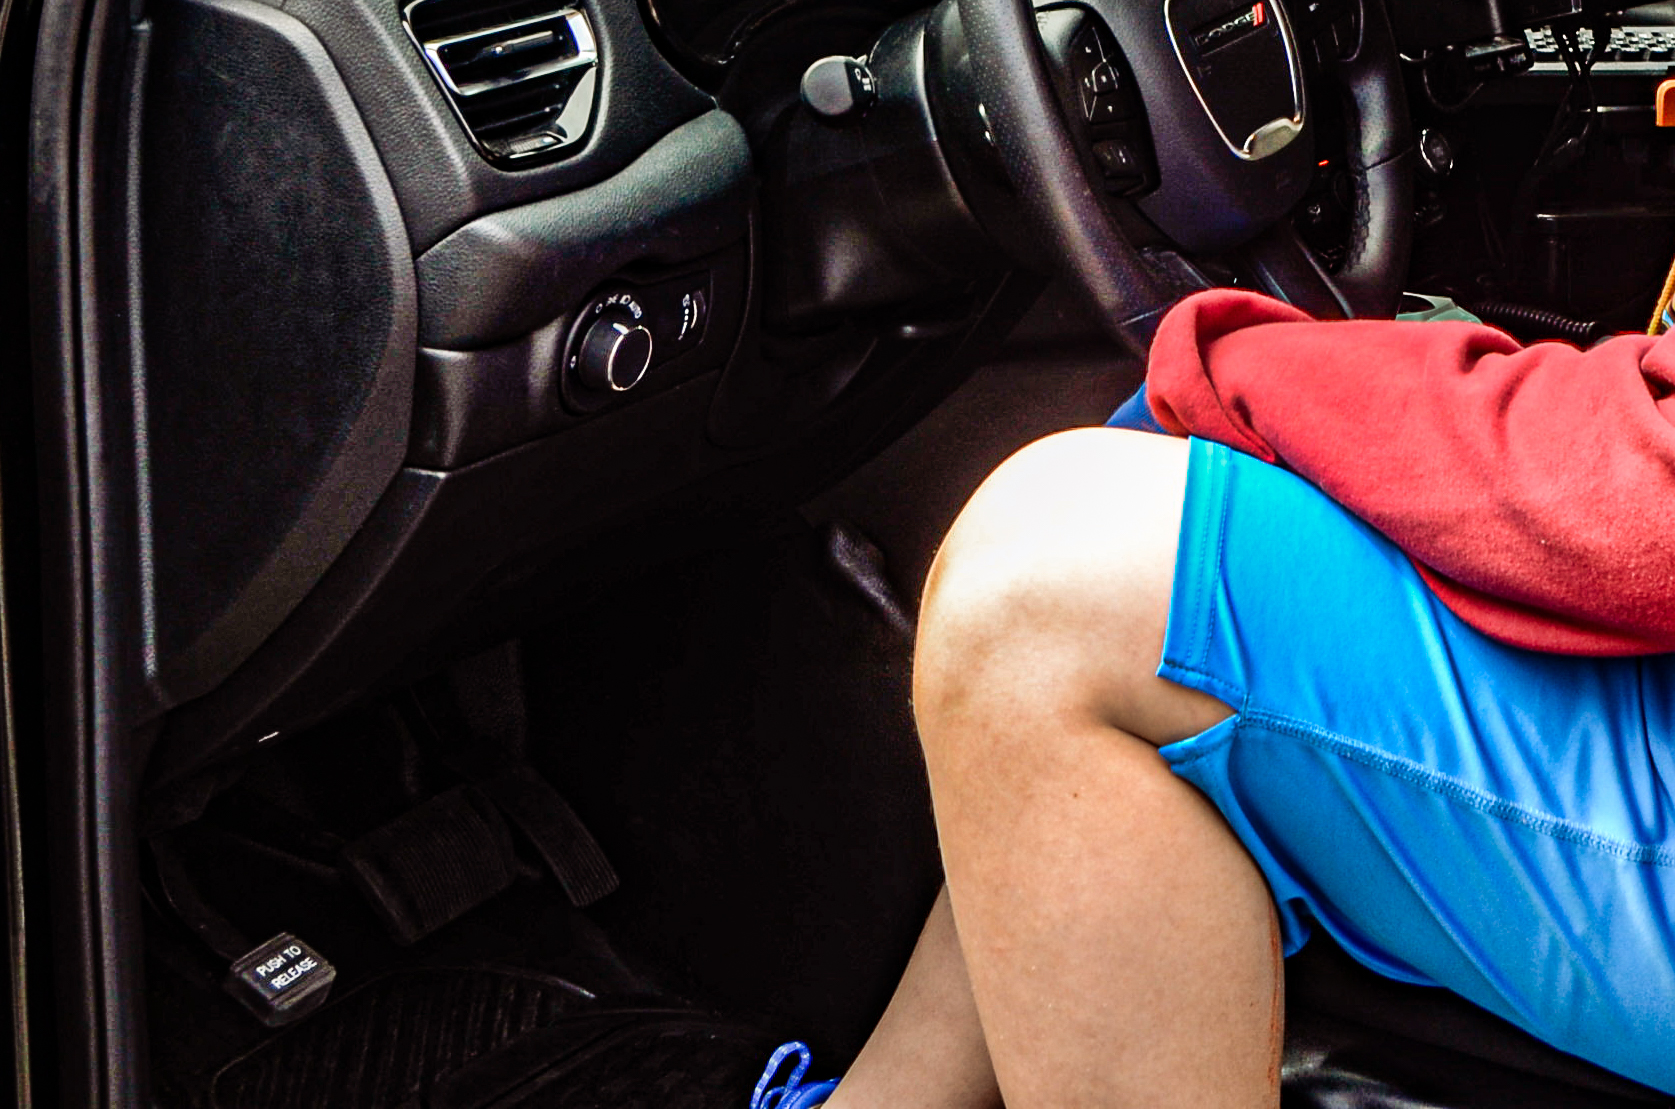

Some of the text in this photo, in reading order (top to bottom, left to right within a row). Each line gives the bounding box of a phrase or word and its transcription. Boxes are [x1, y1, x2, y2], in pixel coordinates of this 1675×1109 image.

[256, 945, 302, 977] PUSH TO
[271, 956, 318, 989] RELEASE
